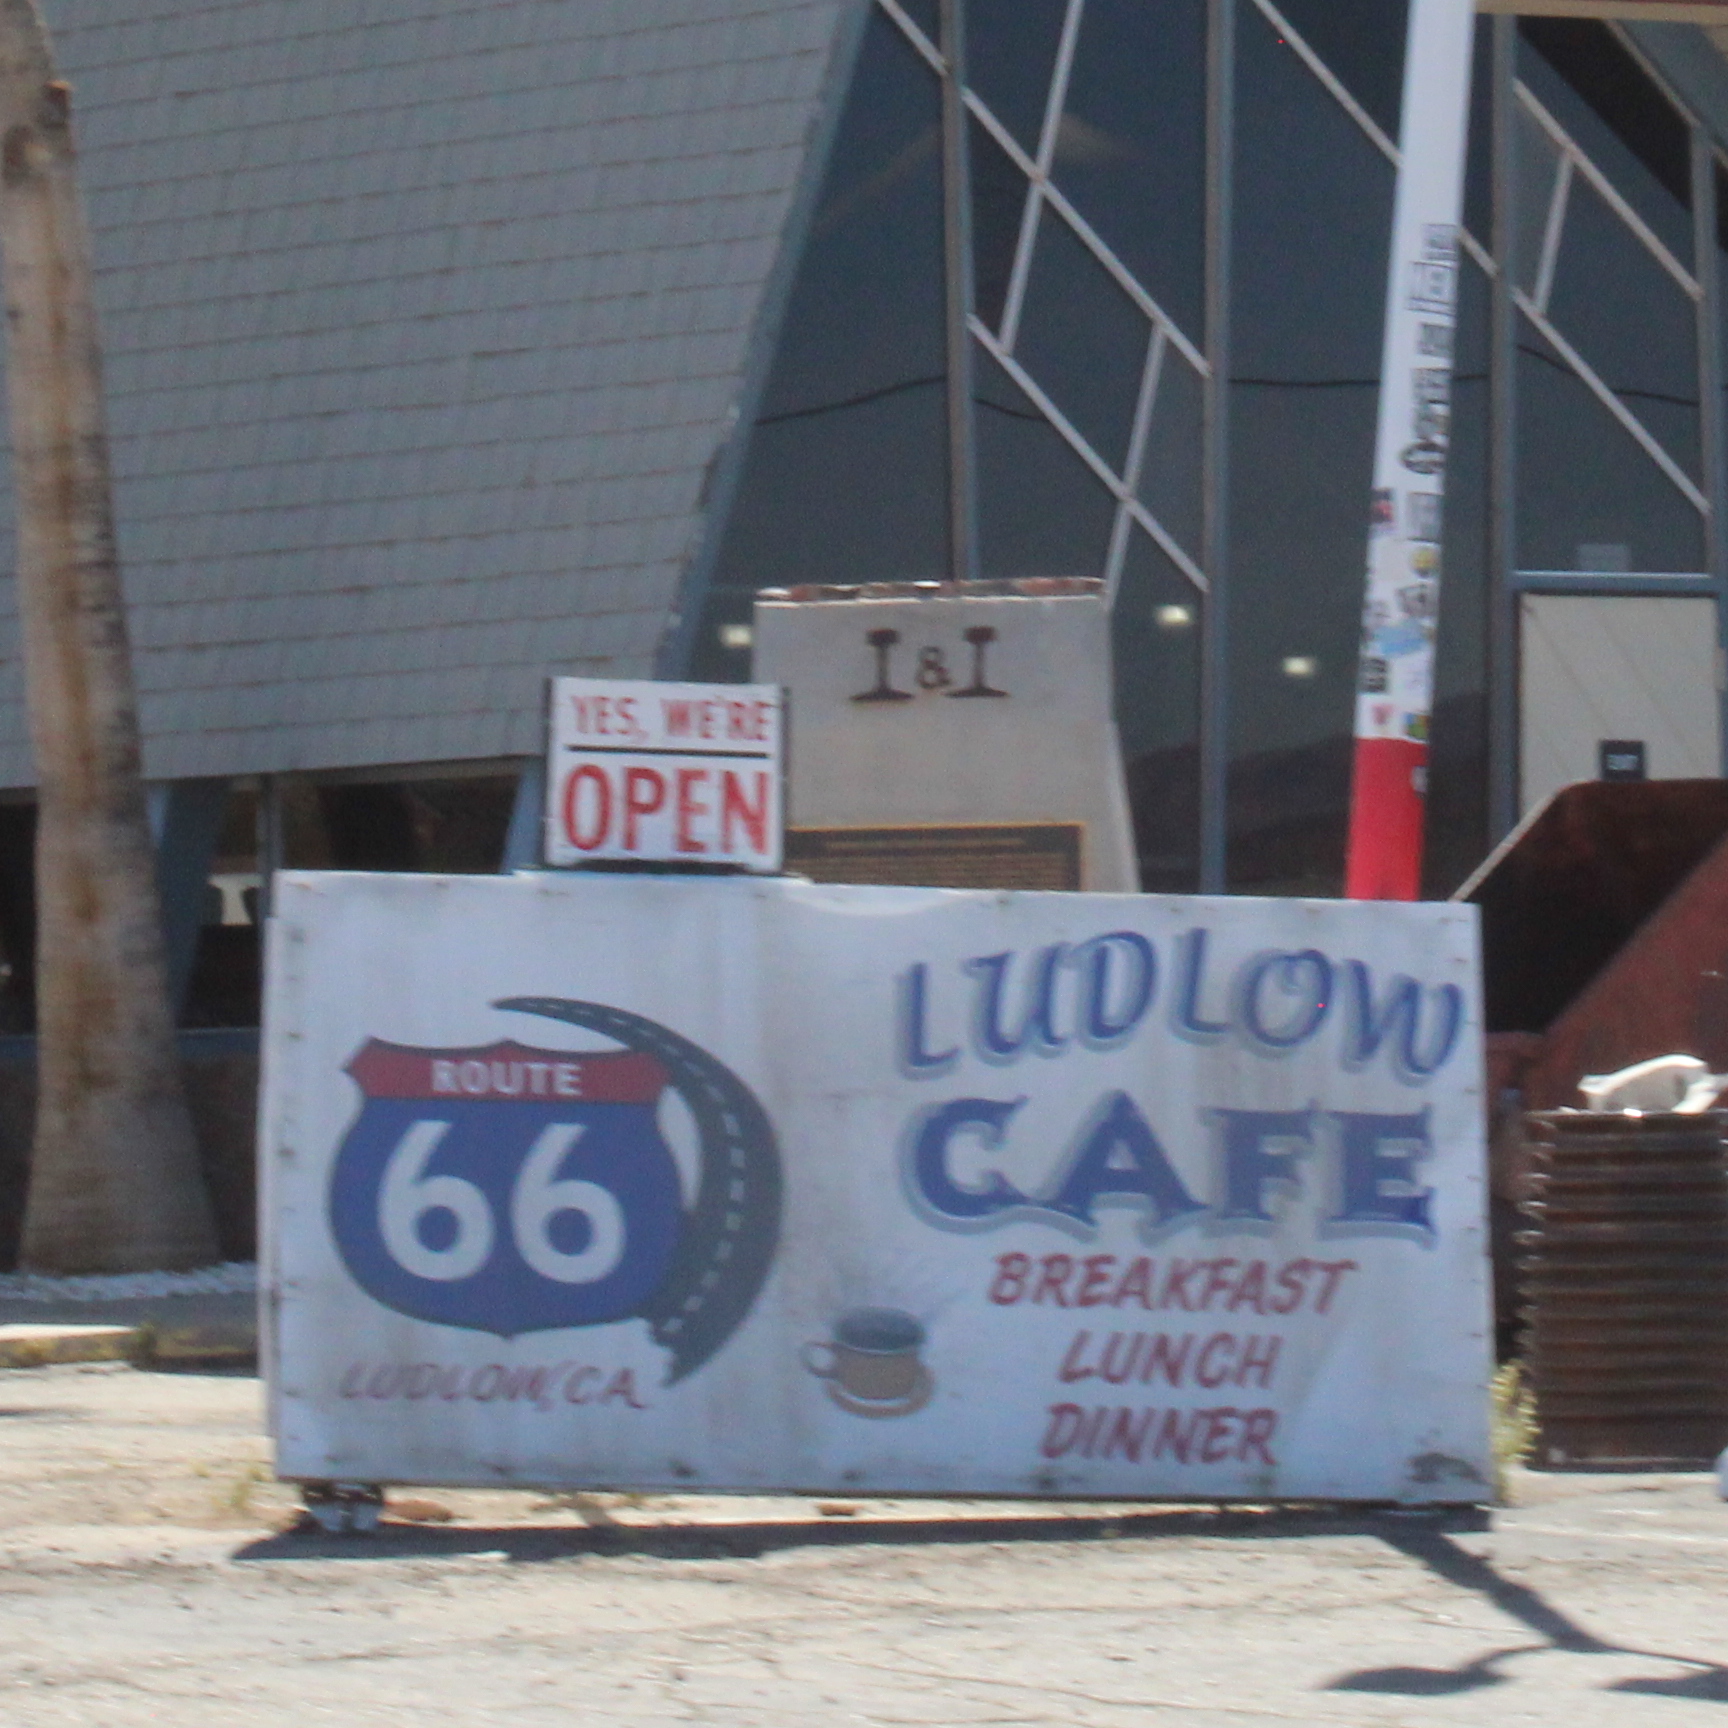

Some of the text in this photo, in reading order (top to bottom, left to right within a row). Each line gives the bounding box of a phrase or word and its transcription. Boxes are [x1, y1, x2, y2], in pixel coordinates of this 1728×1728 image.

[573, 695, 771, 742] YES, WE'RE
[561, 764, 770, 855] OPEN
[898, 927, 1464, 1087] LUDLOW
[431, 1057, 583, 1099] ROUTE
[897, 1088, 1436, 1248] CAFE
[376, 1118, 627, 1284] 66
[987, 1251, 1360, 1316] BREAKFAST
[1057, 1329, 1284, 1390] LUNCH
[1038, 1402, 1280, 1466] DINNER
